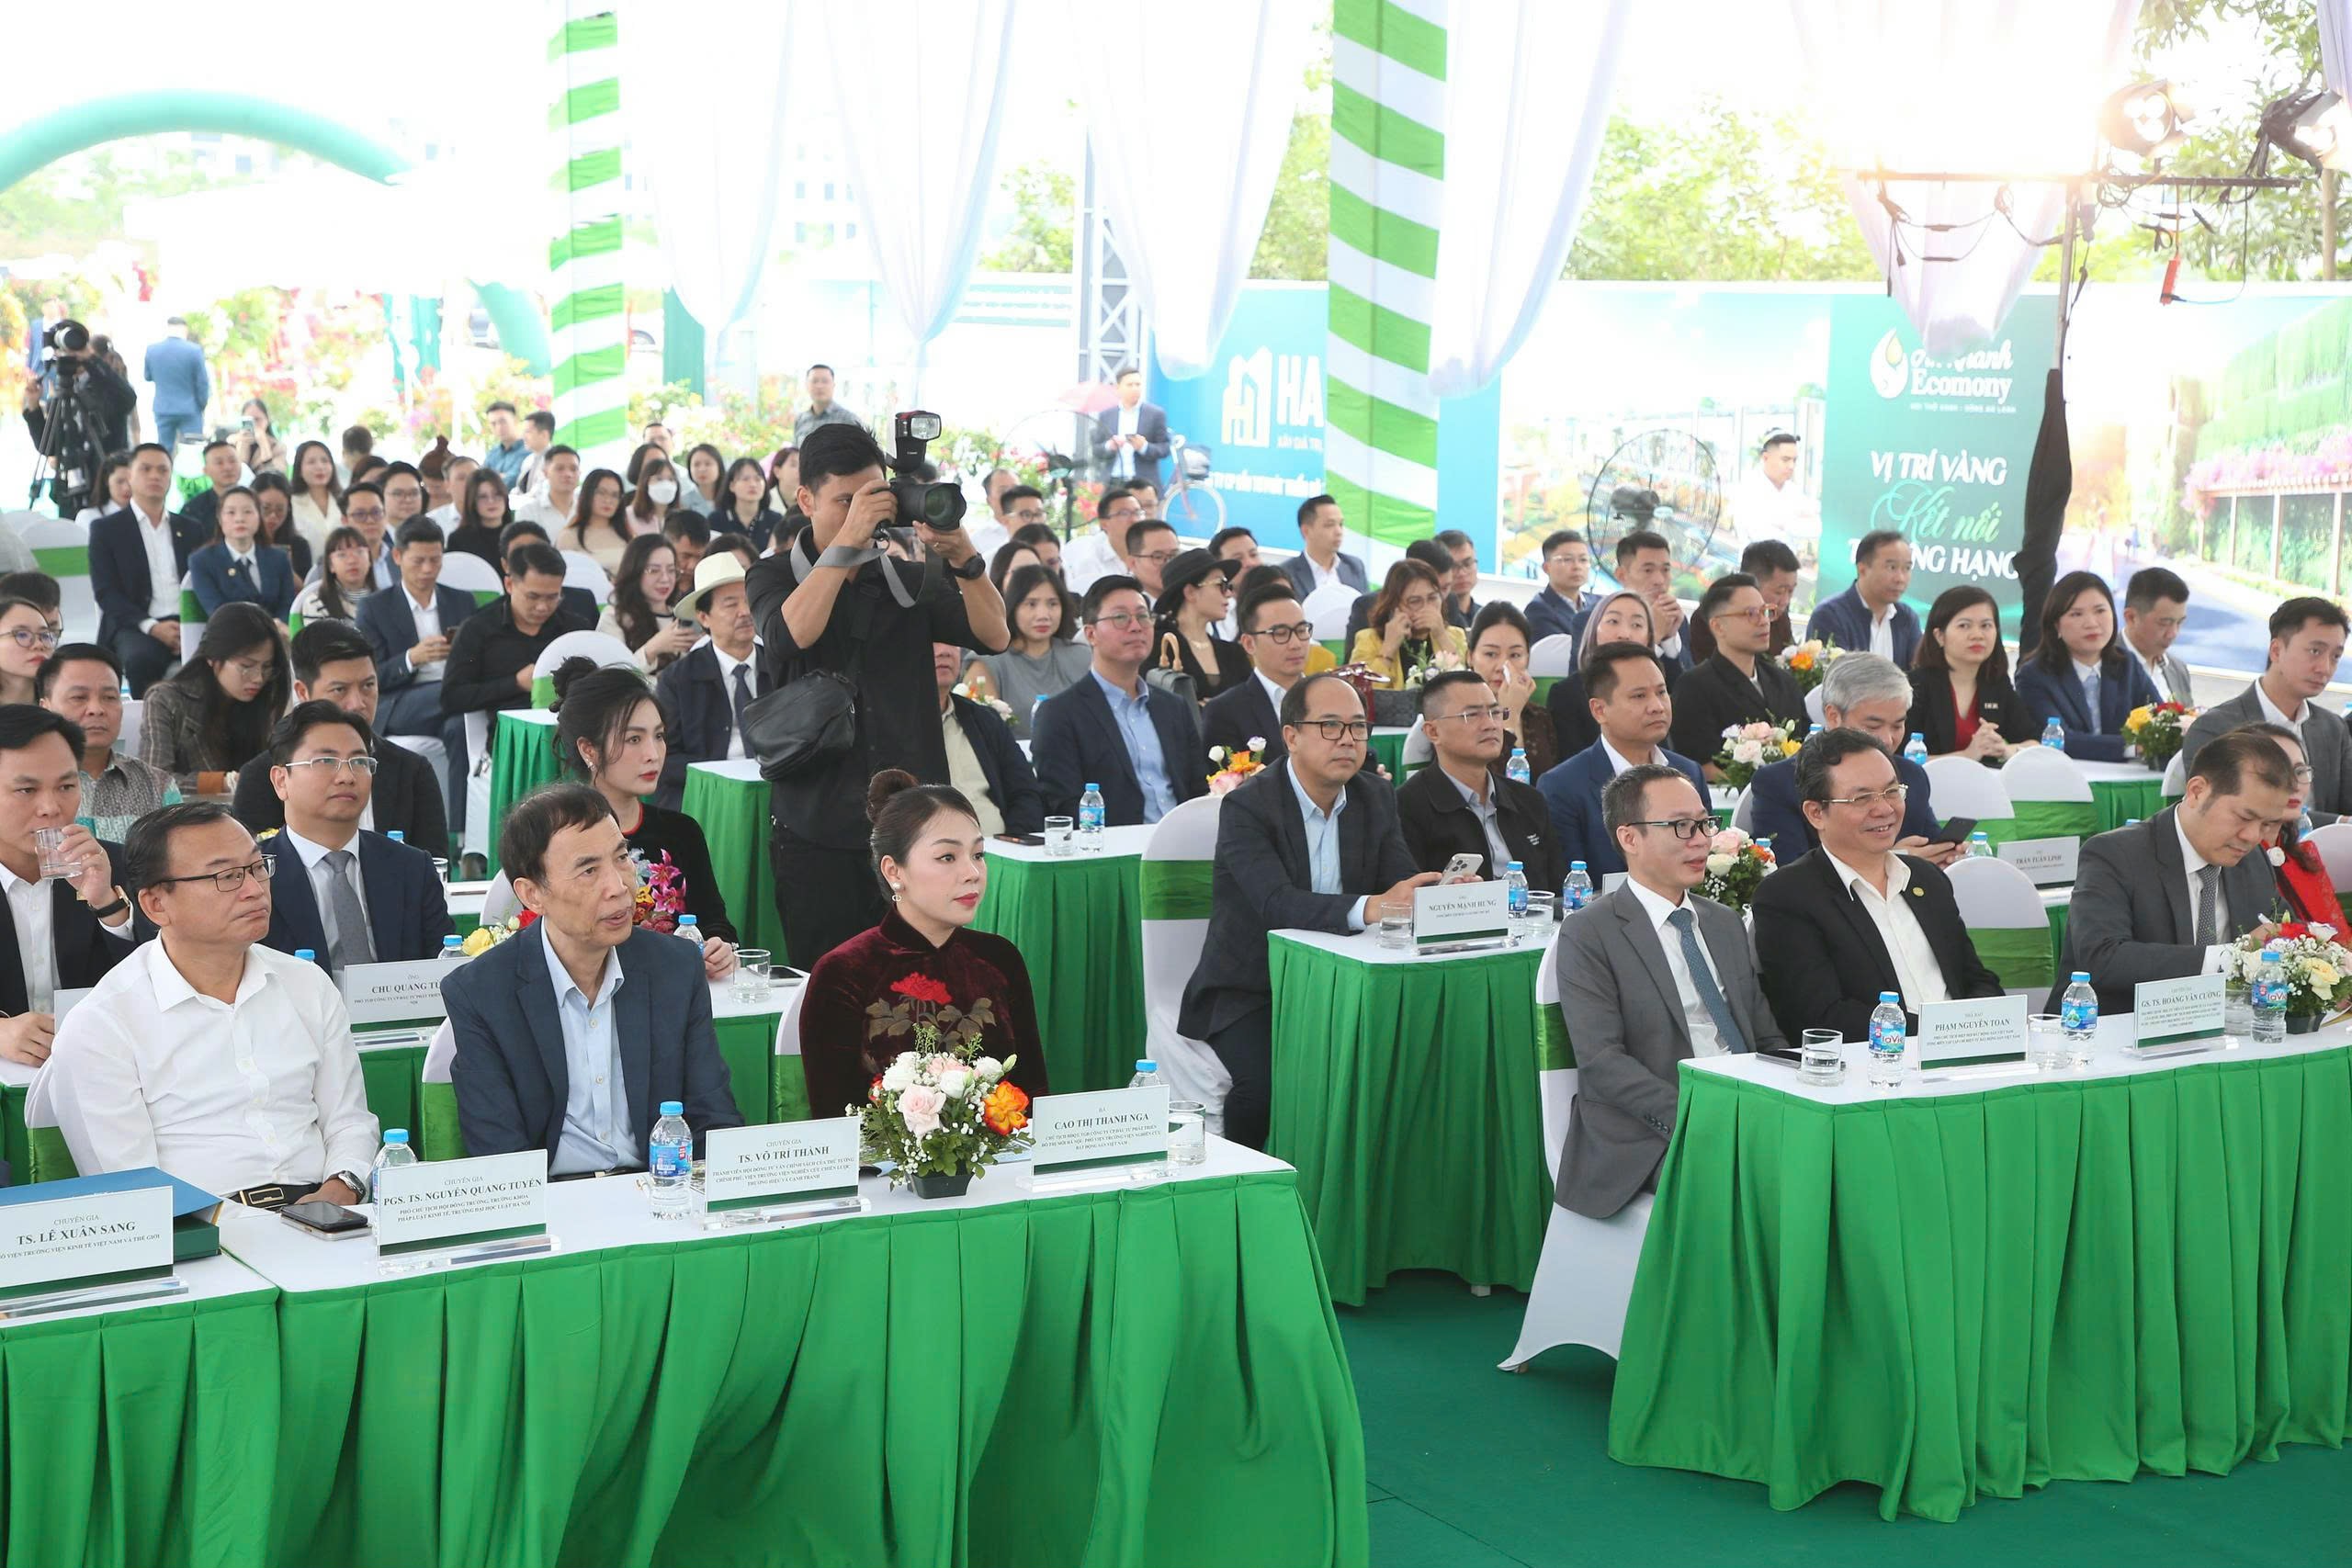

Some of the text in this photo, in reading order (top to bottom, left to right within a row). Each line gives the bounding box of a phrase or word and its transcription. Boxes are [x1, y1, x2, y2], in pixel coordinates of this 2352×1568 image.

[1911, 367, 2013, 404] Ecomony
[1871, 448, 2007, 485] VỊ TRÍ VÀNG
[1871, 479, 2003, 543] Kết nối
[371, 986, 392, 994] CHU
[394, 983, 426, 994] QUANG
[1055, 1112, 1149, 1131] CAO THỊ THANH NGA
[766, 1139, 791, 1148] CHUYÊN
[738, 1145, 830, 1165] TS. VÕ TRÍ THÀNH
[444, 1177, 471, 1187] CHUYÊN
[384, 1178, 542, 1207] PGS. TS. NGUYỄN QUANG TUYẾN
[53, 1213, 99, 1227] CHUYÊN GIA
[17, 1221, 136, 1247] TS. LÊ XUÂN SANG
